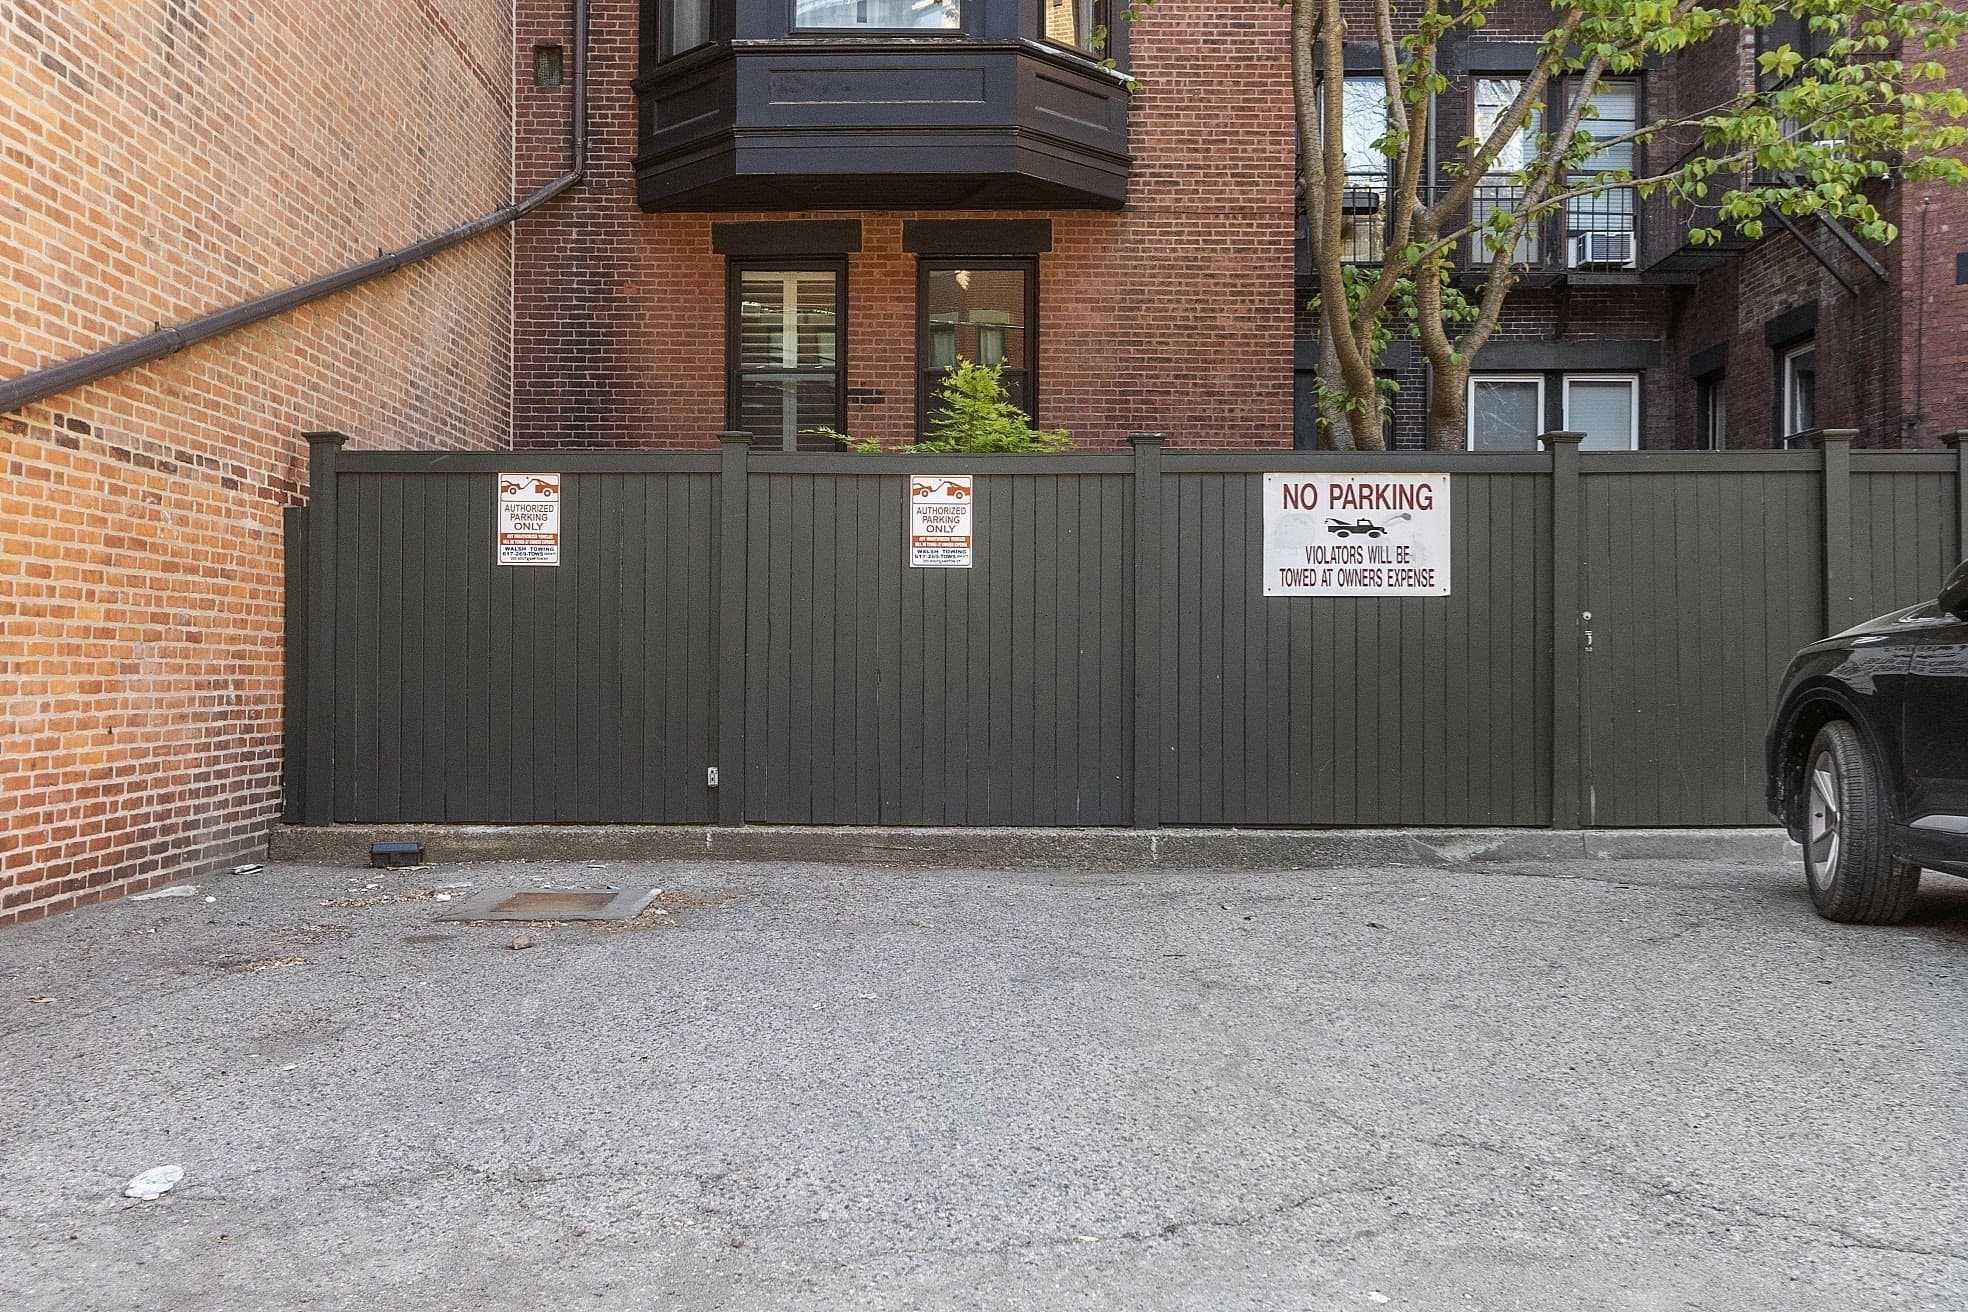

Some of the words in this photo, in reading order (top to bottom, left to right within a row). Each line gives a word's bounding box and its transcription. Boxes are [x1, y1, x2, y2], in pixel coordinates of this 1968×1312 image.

[1283, 483, 1317, 510] NO
[1329, 483, 1433, 510] PARKING
[510, 513, 548, 521] PARKING
[922, 515, 960, 524] PARKING
[926, 525, 956, 533] ONLY
[1305, 545, 1363, 564] VIOLATORS
[1367, 545, 1392, 564] WILL
[1396, 545, 1410, 564] BE
[1279, 568, 1317, 587] TOWED
[1320, 568, 1334, 587] AT
[1337, 568, 1383, 587] OWNERS
[1387, 568, 1435, 587] EXPENSE
